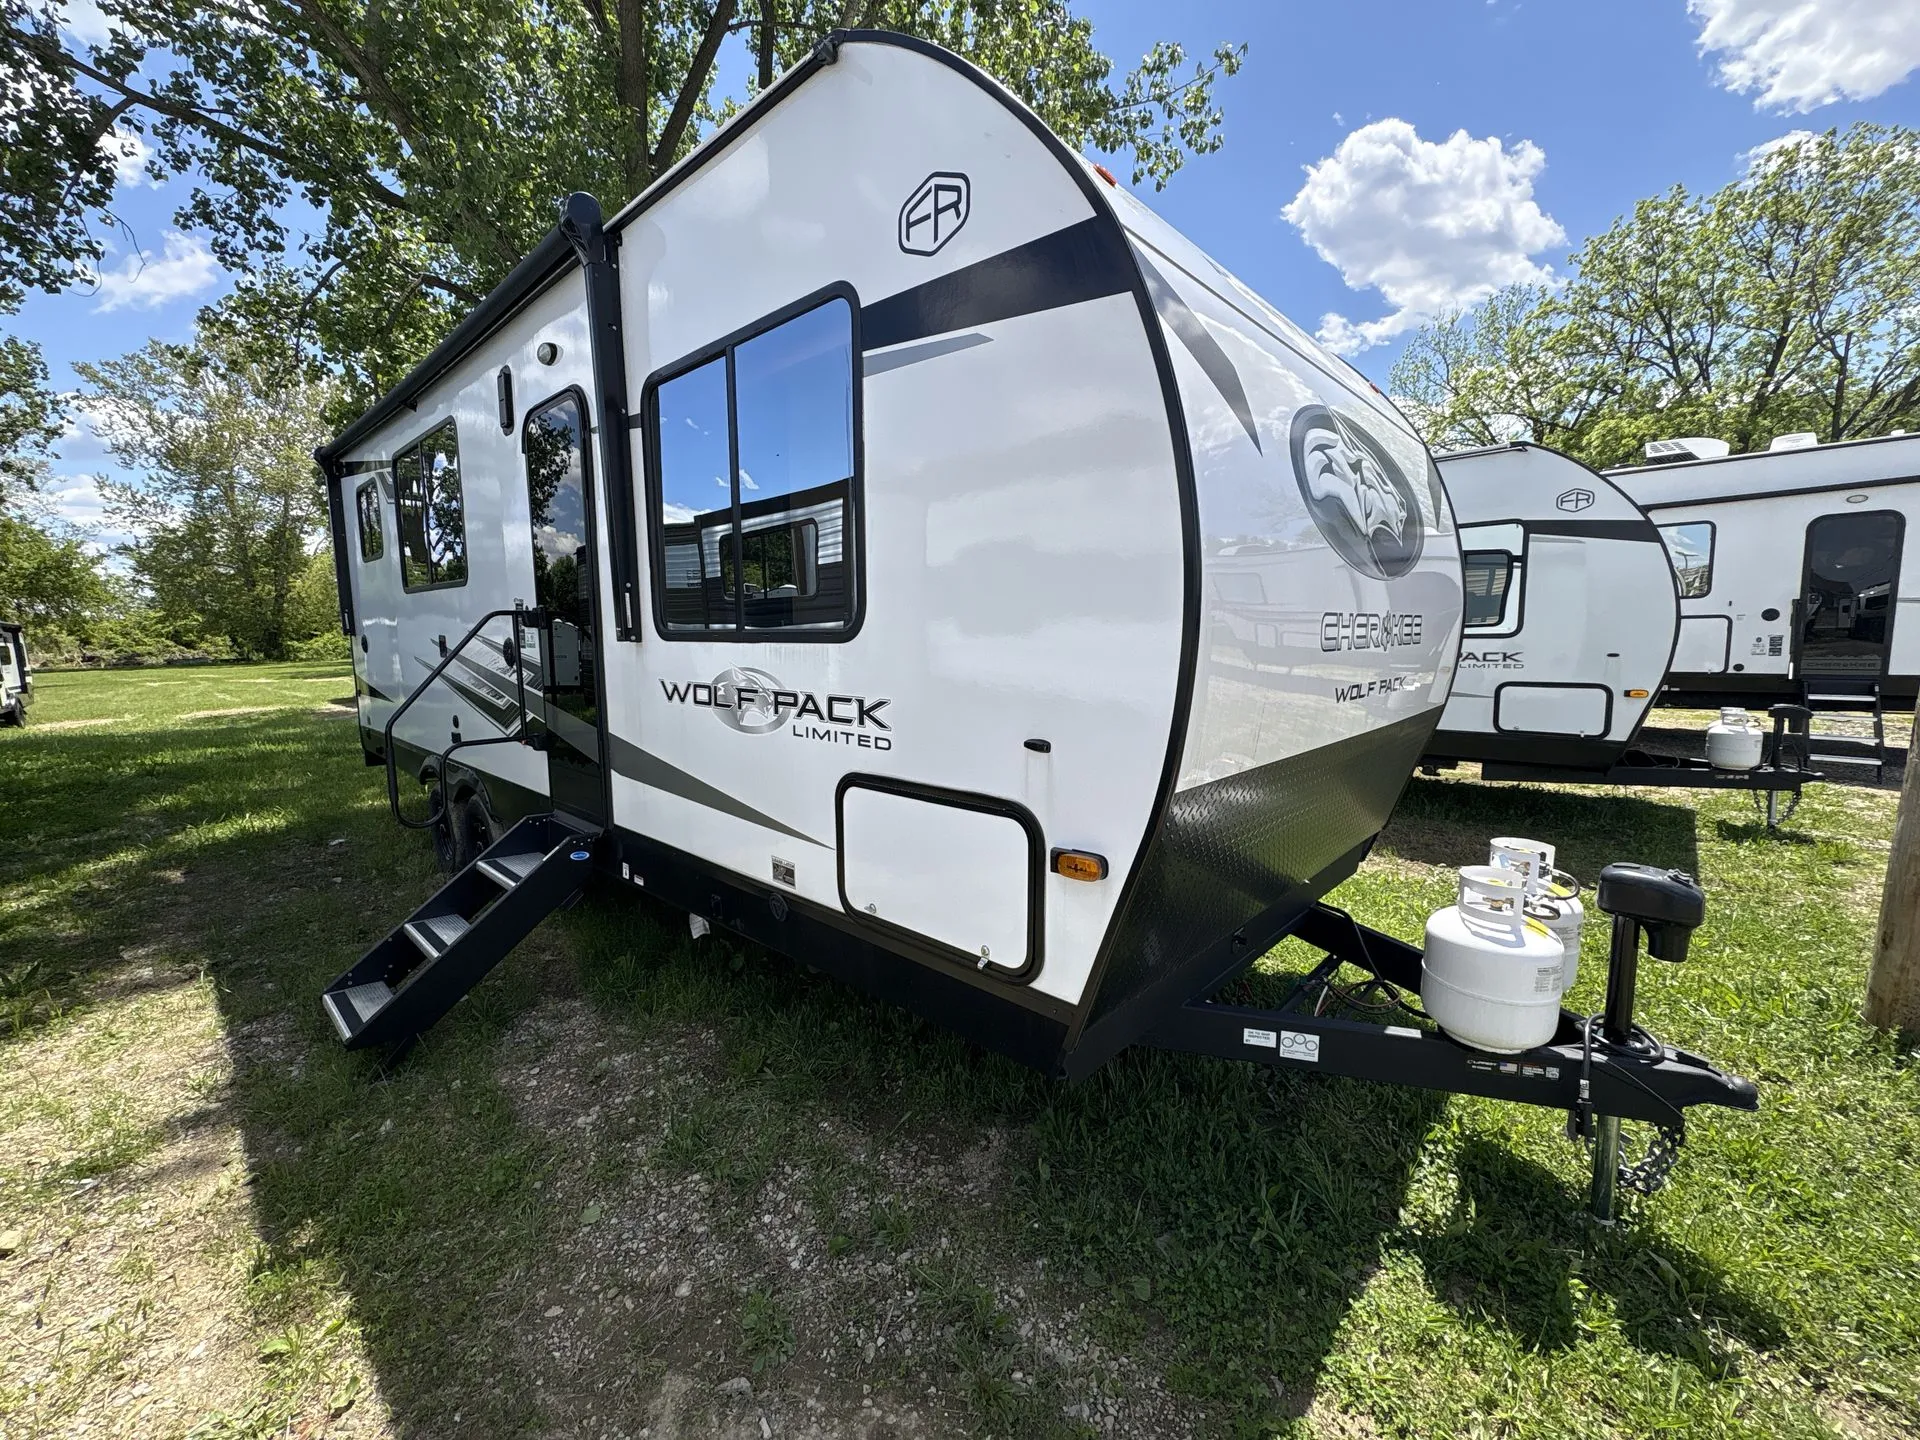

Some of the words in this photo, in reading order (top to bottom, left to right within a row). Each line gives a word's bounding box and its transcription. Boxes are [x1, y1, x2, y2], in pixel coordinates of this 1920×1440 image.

[905, 183, 963, 244] FR
[659, 678, 759, 711] WOLF
[770, 689, 892, 731] PACK
[1335, 681, 1377, 703] WOLF
[1378, 676, 1407, 695] PACK
[792, 725, 892, 751] LIMITED
